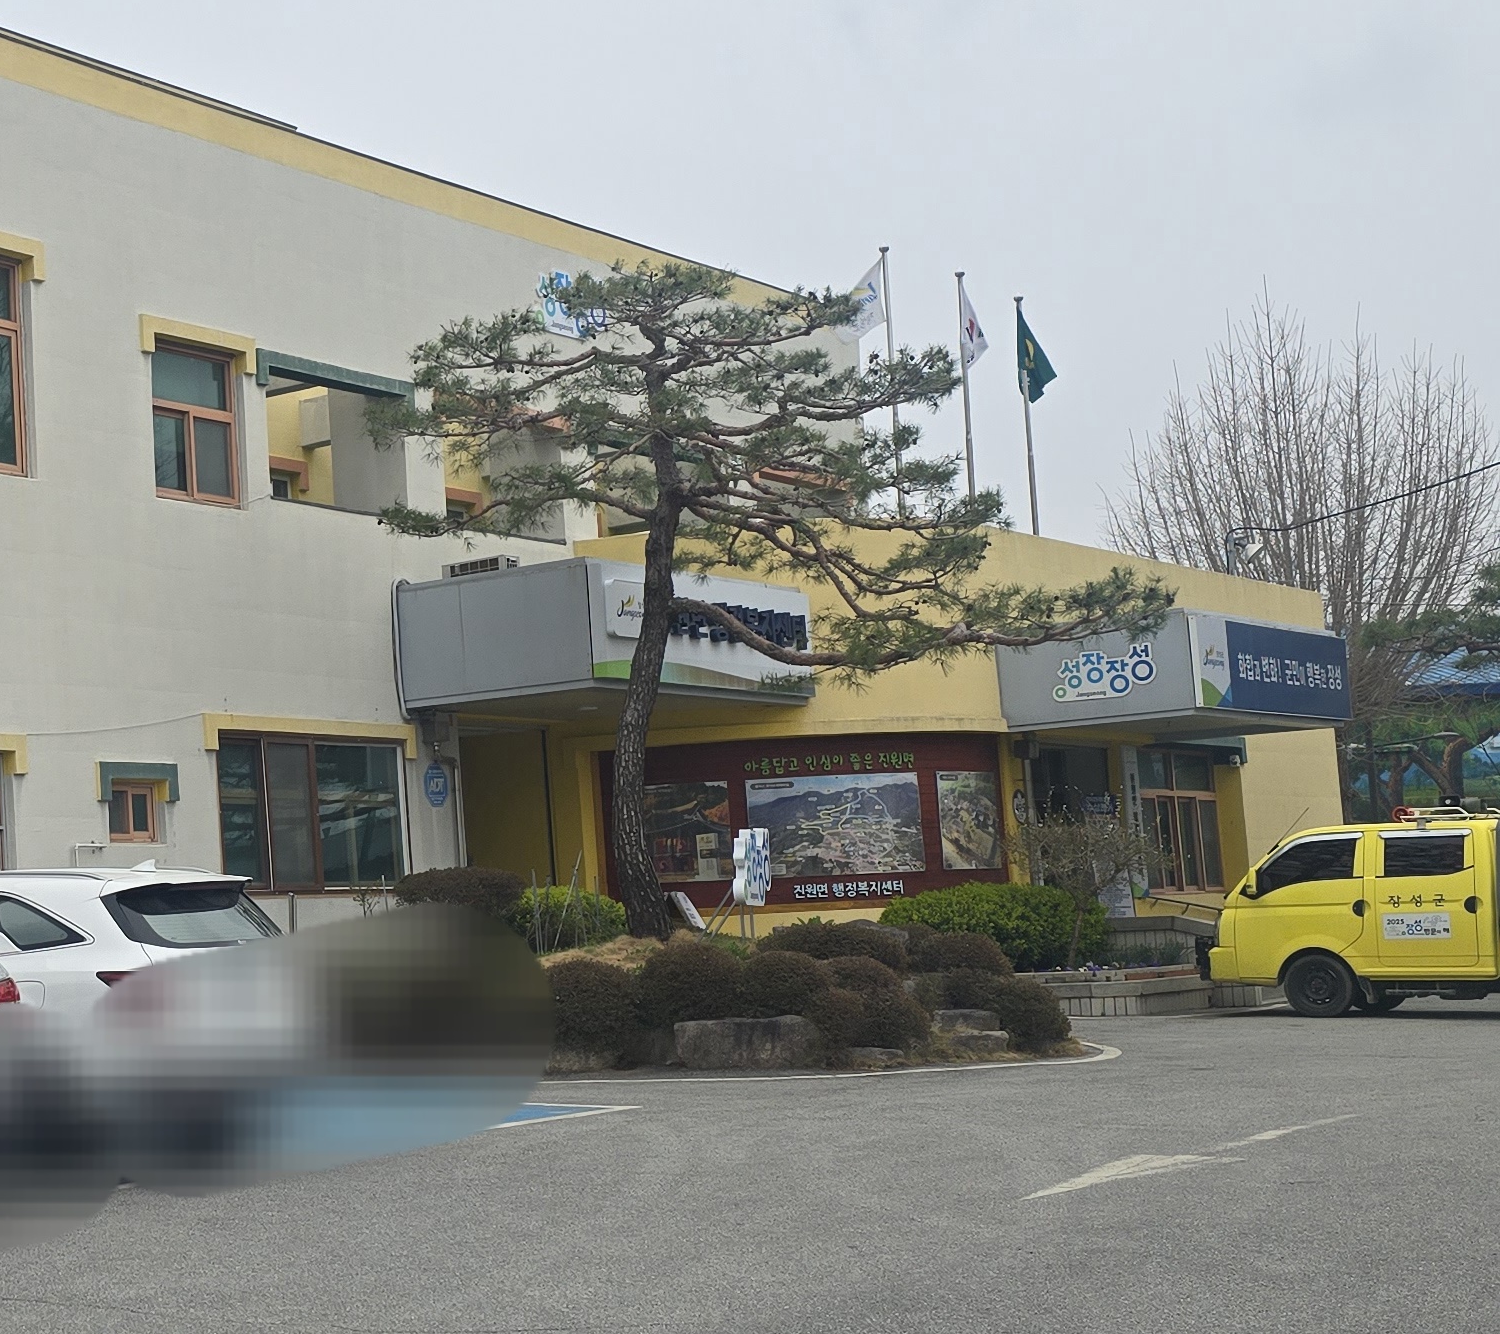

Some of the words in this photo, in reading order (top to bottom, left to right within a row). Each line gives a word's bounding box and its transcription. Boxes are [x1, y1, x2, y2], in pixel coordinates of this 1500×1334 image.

[1060, 645, 1153, 693] 성장장성
[1238, 652, 1260, 681] 화합과
[1261, 656, 1282, 683] 변화!
[1306, 662, 1327, 688] 행복한
[1327, 664, 1342, 690] 장성
[745, 758, 799, 775] 아름답고
[805, 755, 843, 770] 인심이
[878, 752, 914, 769] 진원면
[793, 883, 828, 898] 진원면
[832, 880, 904, 897] 행정복지센터
